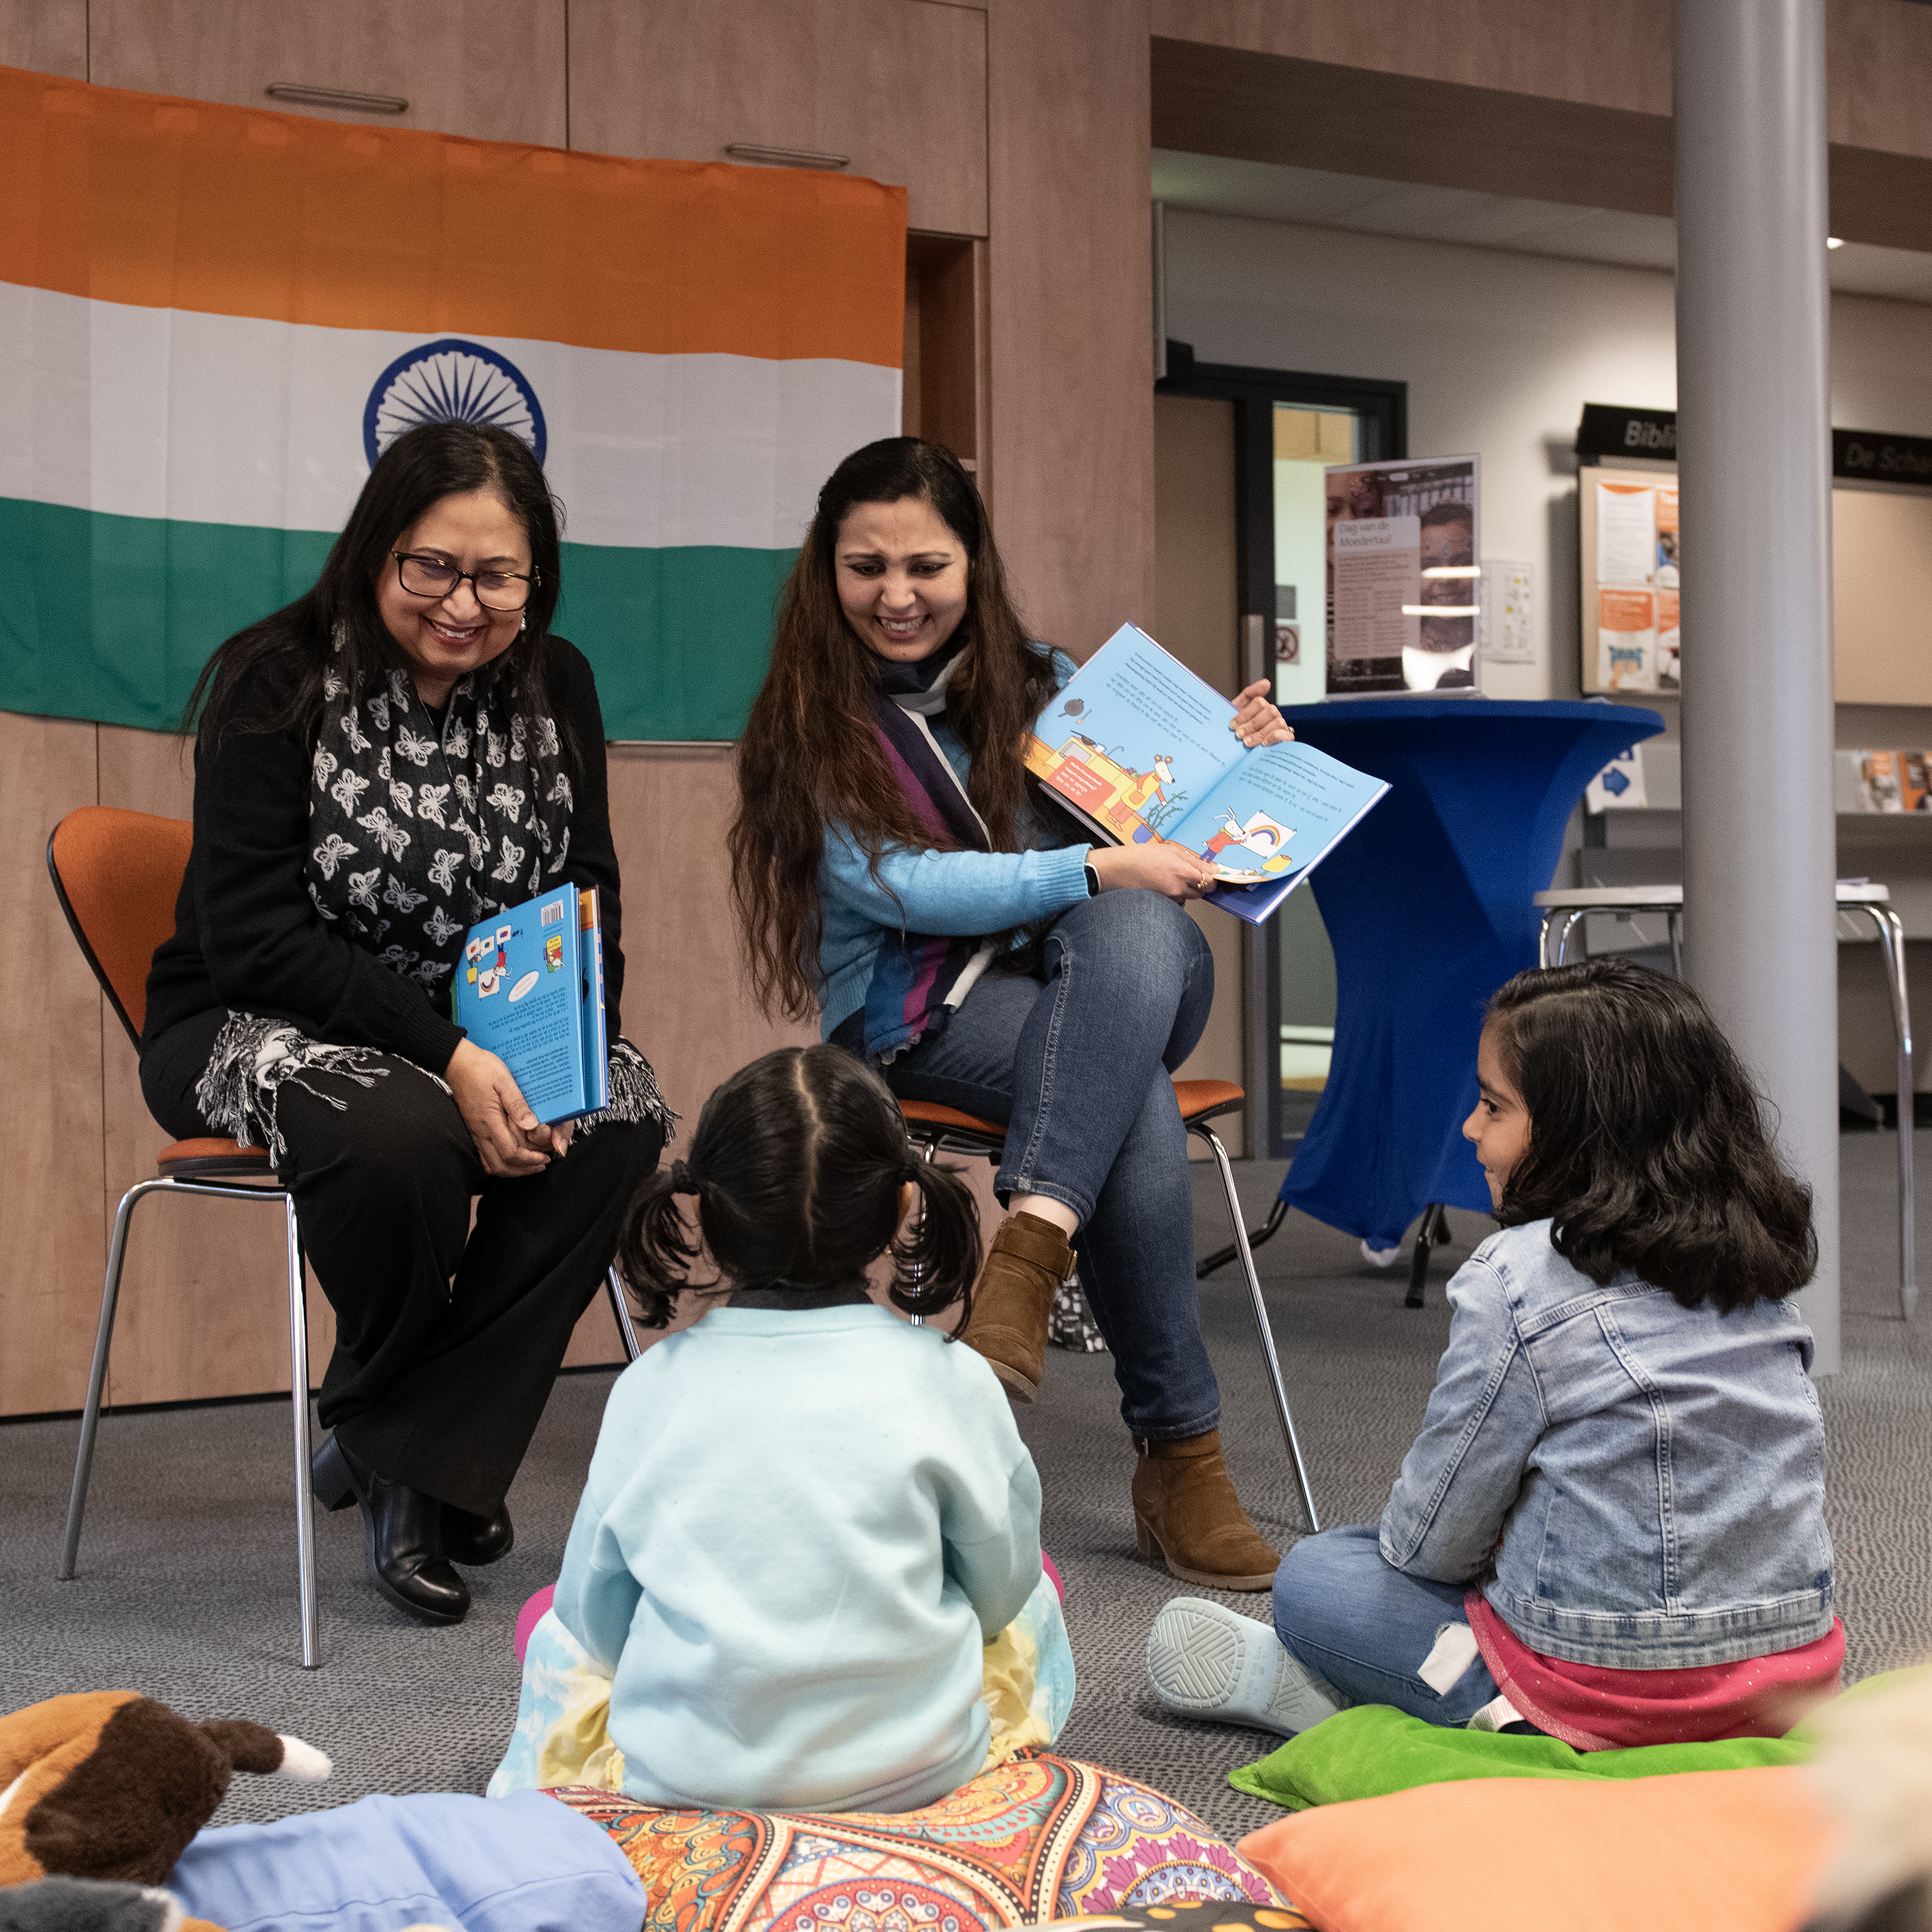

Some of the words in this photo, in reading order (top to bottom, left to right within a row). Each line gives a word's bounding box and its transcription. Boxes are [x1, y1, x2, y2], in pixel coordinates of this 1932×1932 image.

[1844, 442, 1875, 470] De
[1339, 523, 1358, 536] Dag
[1360, 522, 1375, 532] van
[1378, 520, 1390, 531] de
[1339, 534, 1392, 547] Moedertaal
